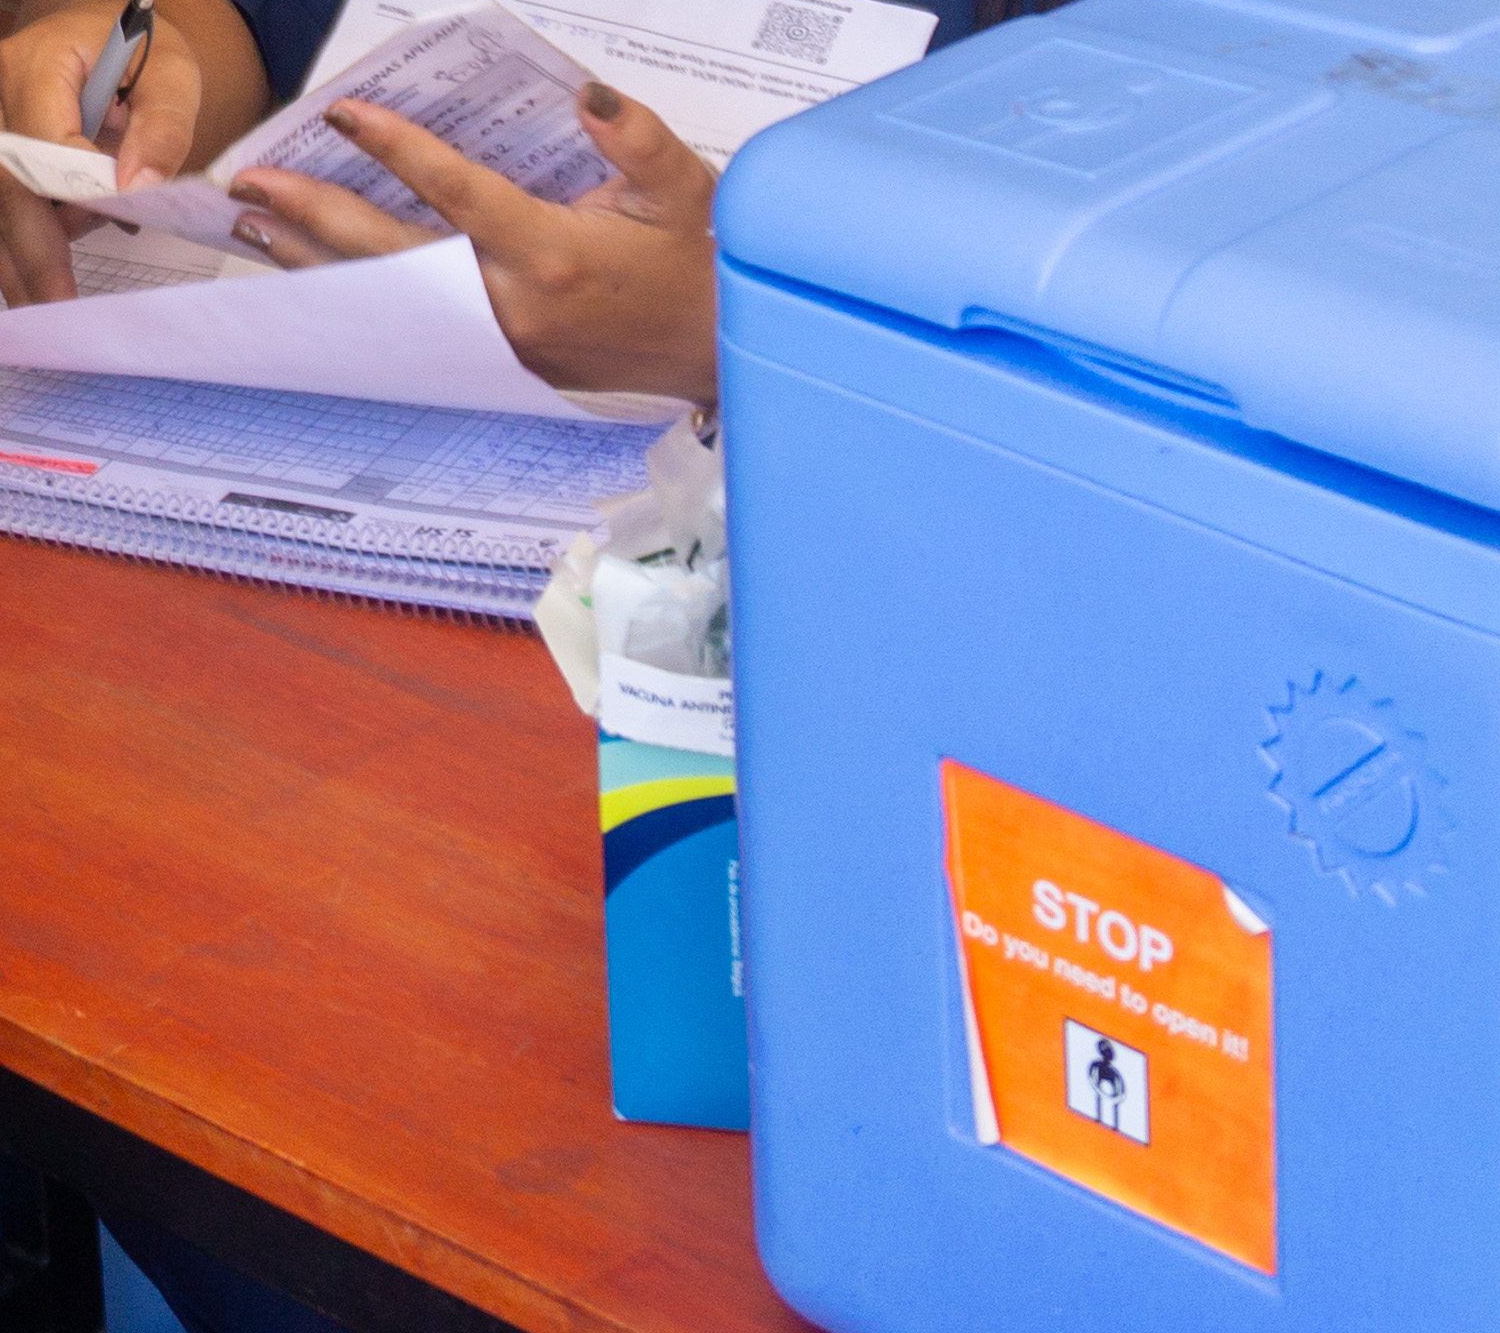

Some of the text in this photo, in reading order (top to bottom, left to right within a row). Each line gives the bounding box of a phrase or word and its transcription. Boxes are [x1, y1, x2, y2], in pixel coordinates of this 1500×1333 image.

[962, 909, 999, 946] Do
[1002, 933, 1049, 970] you
[1053, 956, 1117, 1000] need
[1119, 984, 1149, 1015] to
[1151, 1002, 1218, 1048] open
[1031, 878, 1174, 972] STOP
